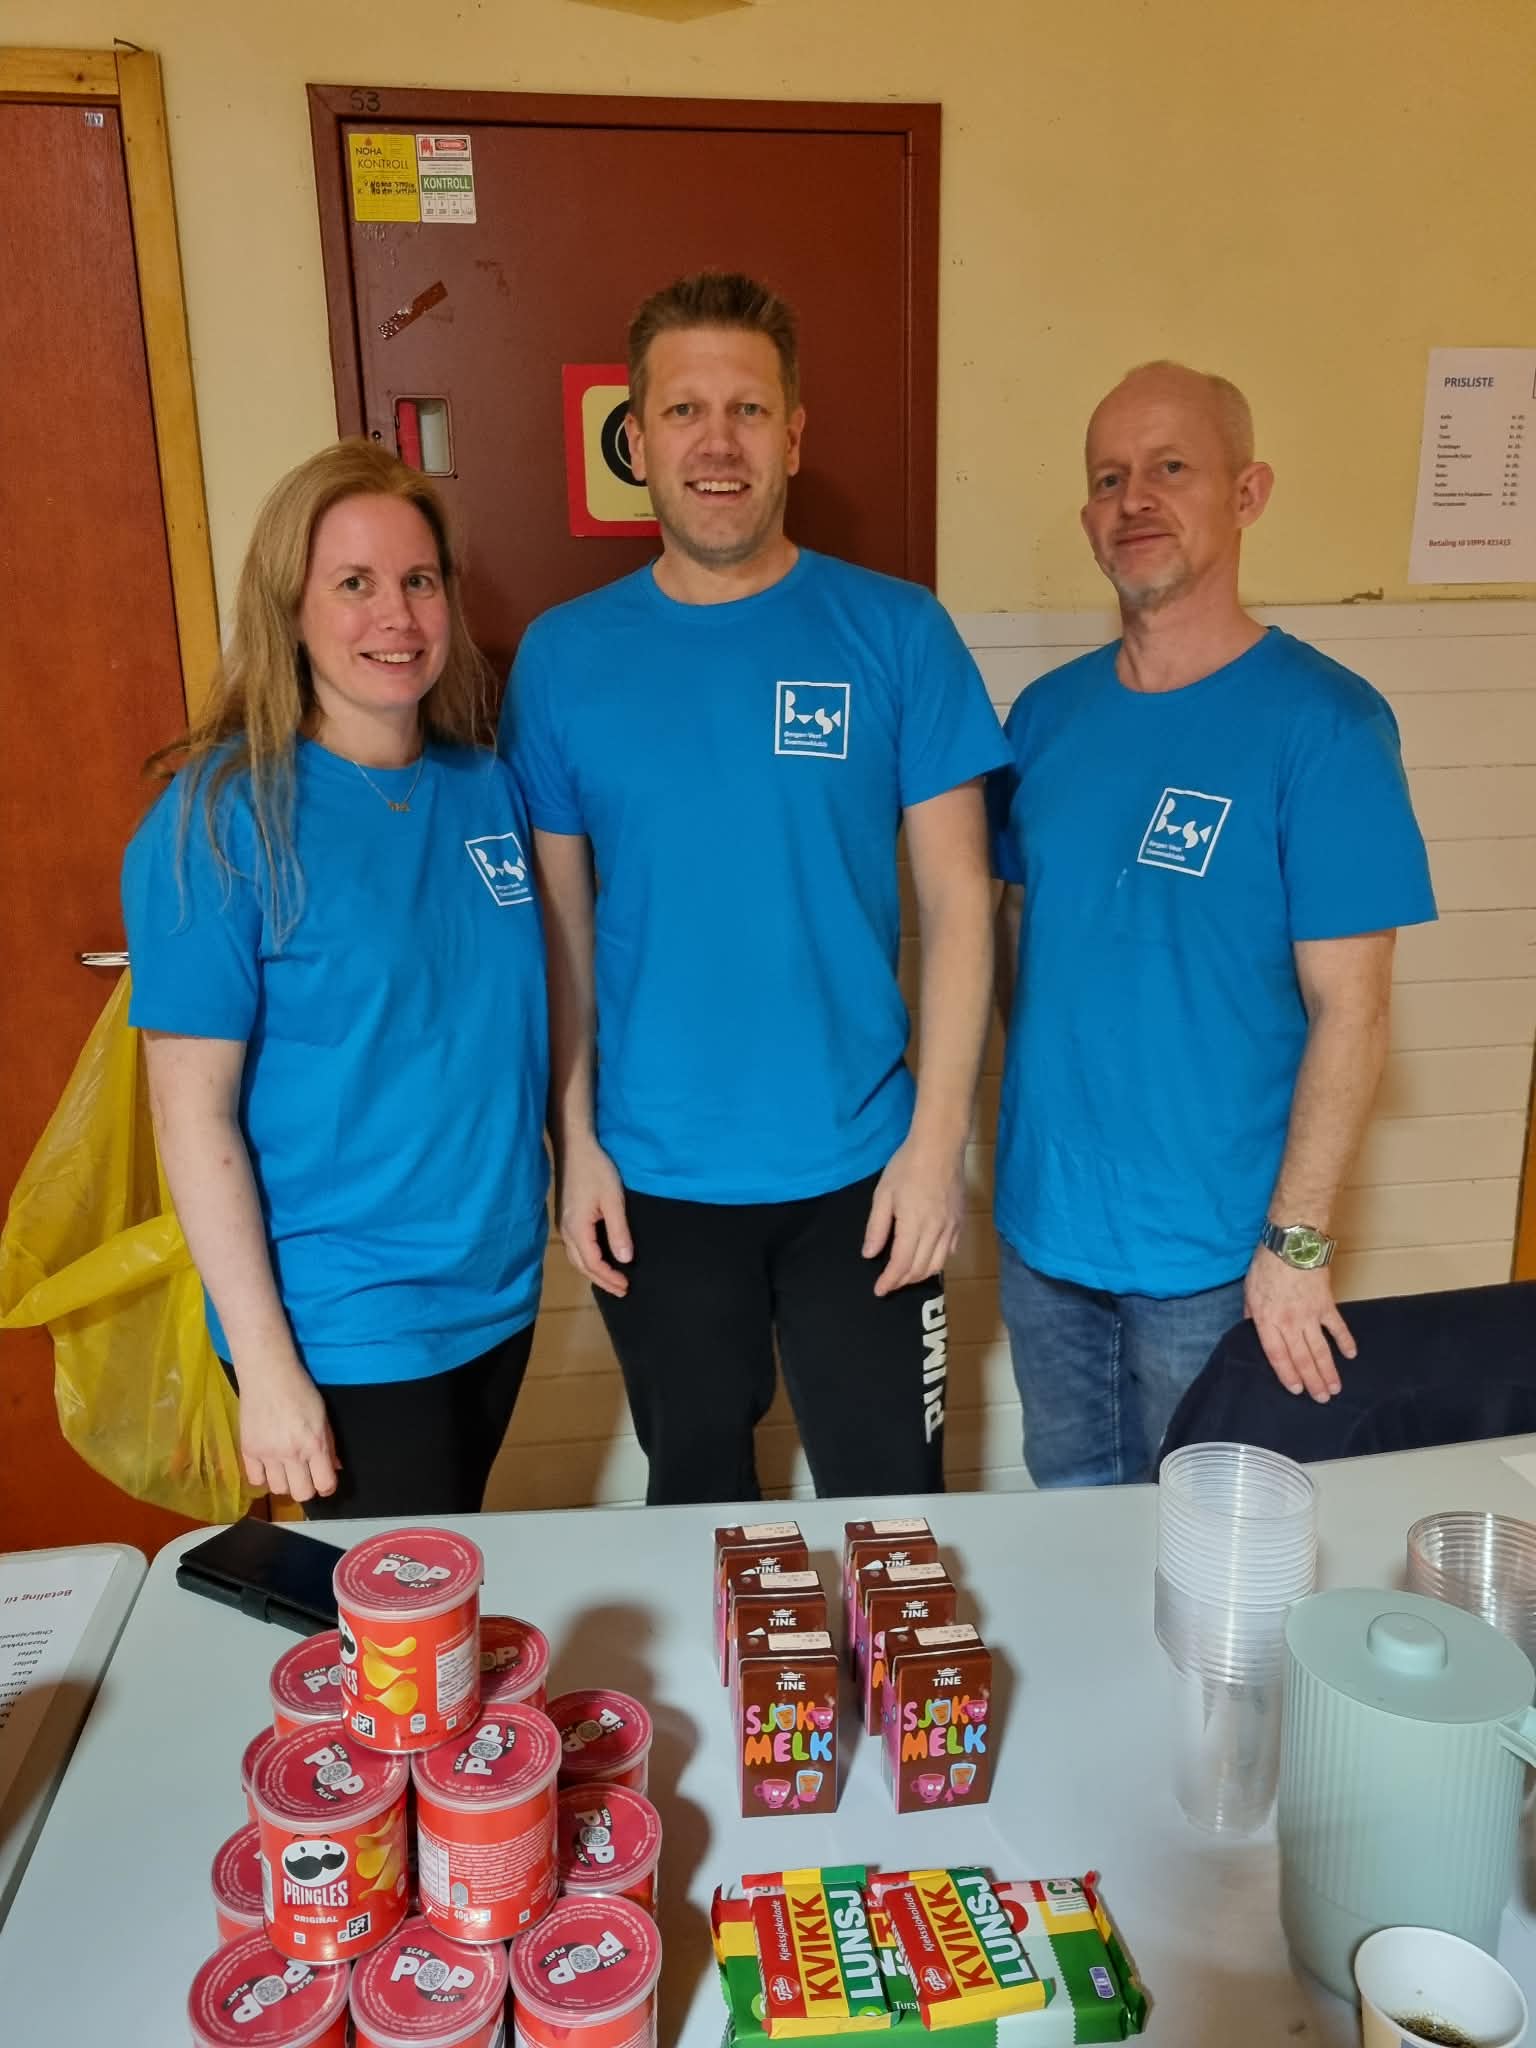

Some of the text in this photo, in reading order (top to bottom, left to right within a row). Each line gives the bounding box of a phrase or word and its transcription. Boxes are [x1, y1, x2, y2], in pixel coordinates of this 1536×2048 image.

[356, 147, 382, 155] NOHA
[358, 159, 409, 170] KONTROLL
[423, 177, 472, 190] KONTROLL
[1444, 377, 1495, 388] PRISLISTE
[388, 1553, 411, 1562] SCAN
[885, 1560, 911, 1569] TINE
[371, 1558, 452, 1582] POP
[756, 1564, 781, 1574] TINE
[4, 1589, 73, 1604] Betaling til
[768, 1617, 797, 1626] TINE
[901, 1609, 929, 1618] TINE
[303, 1667, 327, 1678] SCAN
[303, 1664, 345, 1693] PO
[932, 1676, 962, 1687] TINE
[776, 1681, 806, 1691] TINE
[464, 1724, 503, 1775] POP
[744, 1731, 833, 1766] MELK
[902, 1724, 987, 1762] MELK
[303, 1747, 364, 1795] POP
[574, 1809, 615, 1864] POP
[283, 1878, 348, 1907] PRINGLES
[293, 1914, 339, 1924] ORIGINAL
[904, 1892, 936, 1952] Kjekssjokolade
[771, 1900, 793, 1961] Kjekssjokolade
[921, 1882, 995, 1990] KVIKK
[957, 1876, 1034, 1983] LUNSJ
[405, 1947, 431, 1959] SCAN
[791, 1893, 843, 2001] KVIKK
[829, 1890, 884, 1999] LUNSJ
[548, 1930, 625, 1985] POP
[603, 1951, 626, 1968] SCAN
[390, 1955, 475, 1992] POP
[232, 1960, 311, 2024] POP
[431, 1994, 456, 2002] PLAY
